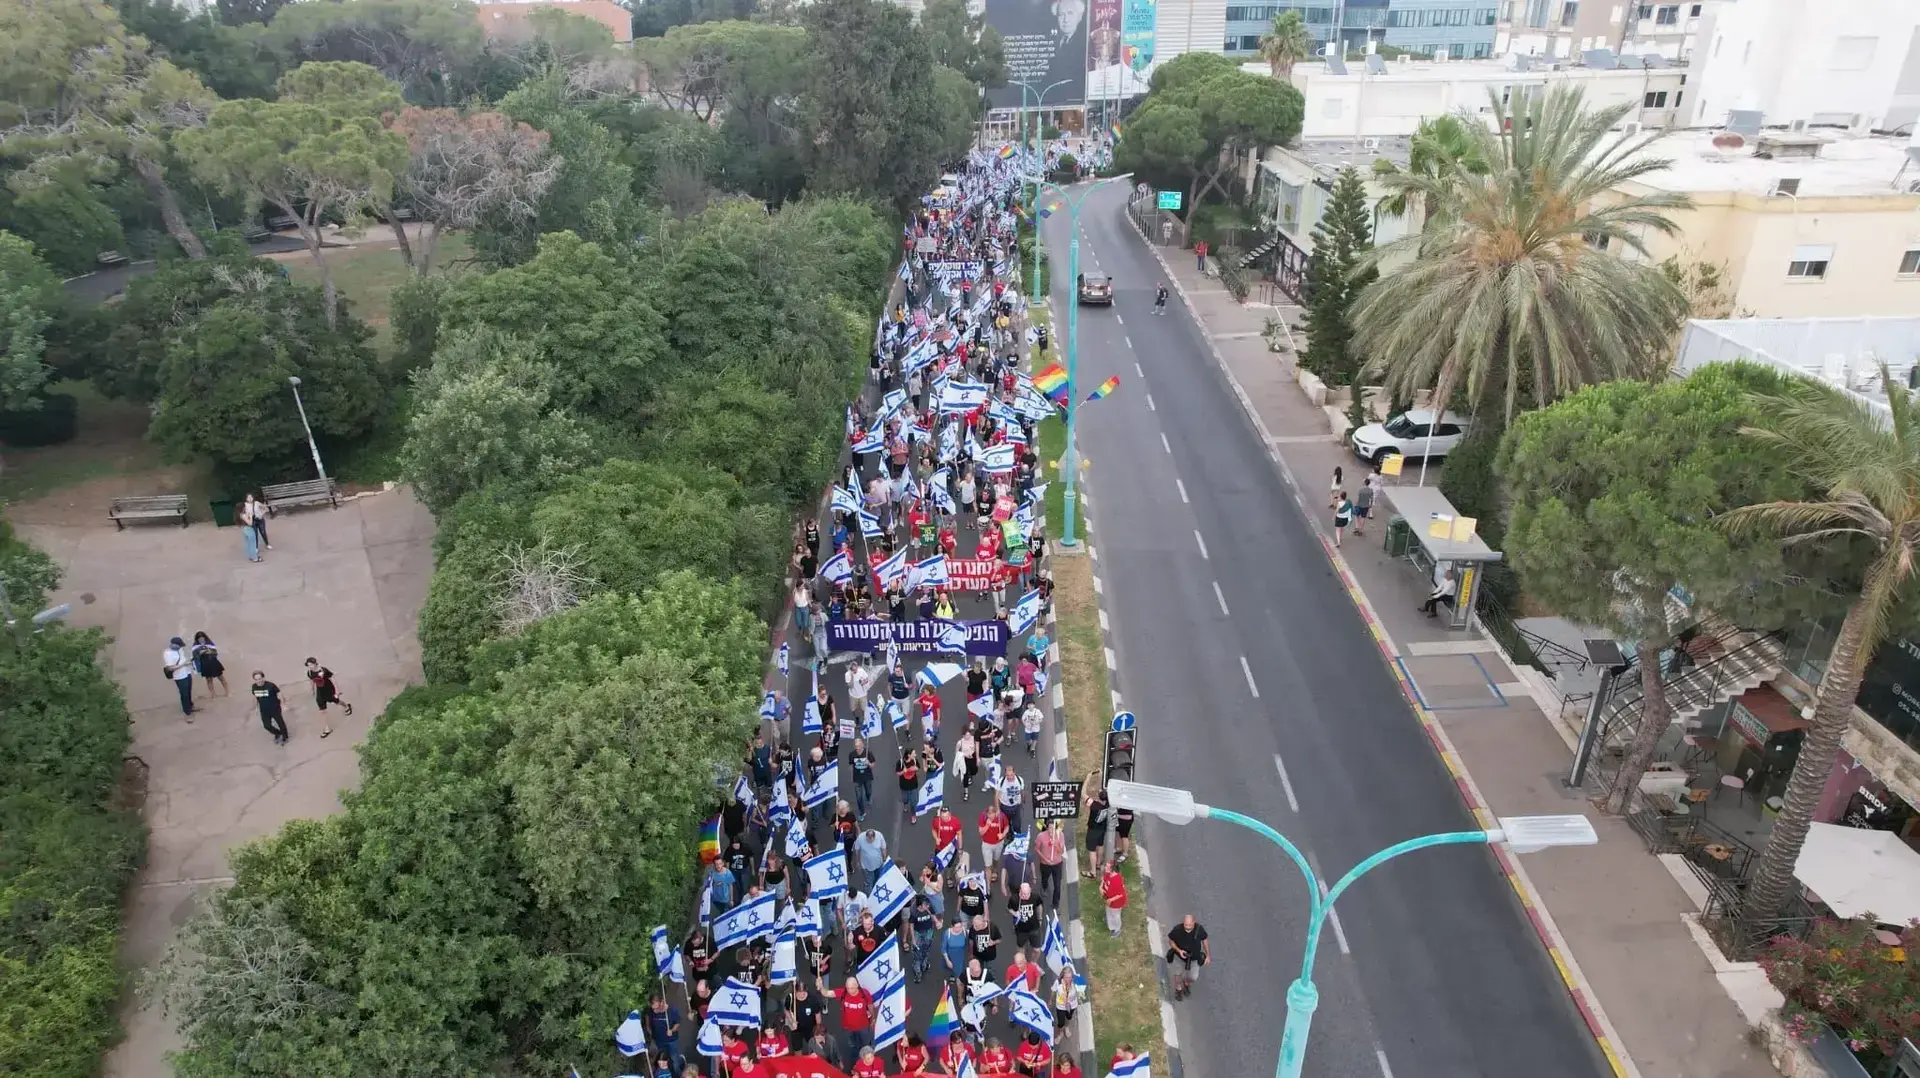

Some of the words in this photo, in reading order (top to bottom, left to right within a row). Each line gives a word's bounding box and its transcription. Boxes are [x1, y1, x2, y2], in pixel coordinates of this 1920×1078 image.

[928, 262, 966, 270] דמוקריה
[1036, 783, 1079, 792] דמוקרטיה
[1858, 785, 1887, 812] BIRDY
